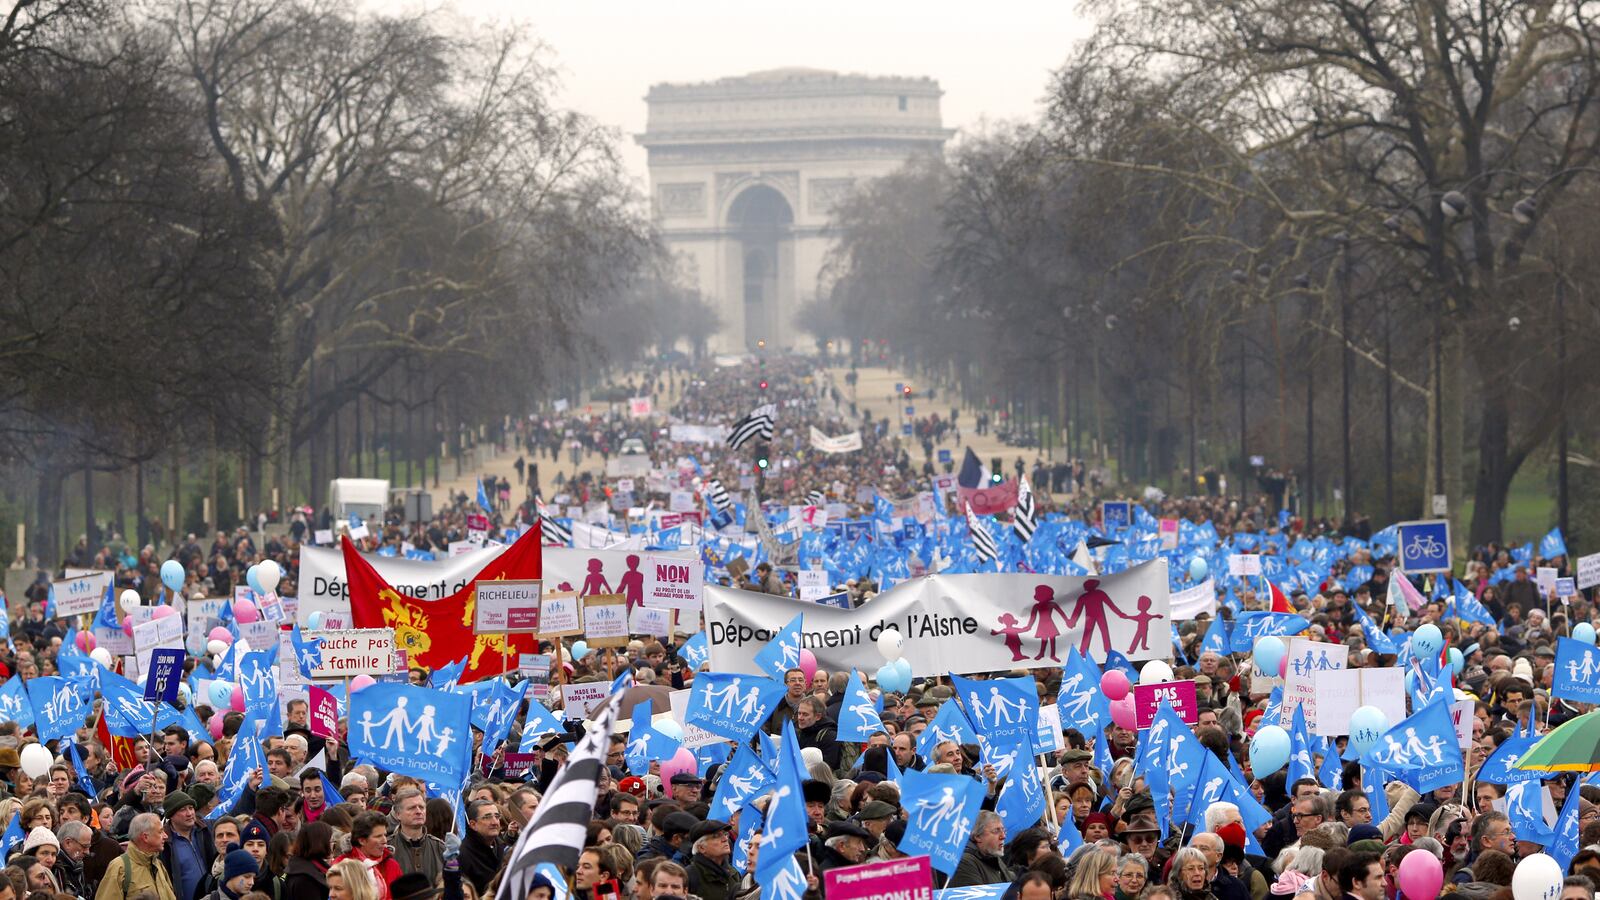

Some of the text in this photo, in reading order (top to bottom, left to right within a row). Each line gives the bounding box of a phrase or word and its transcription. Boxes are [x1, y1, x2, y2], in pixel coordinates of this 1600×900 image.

[656, 564, 690, 584] NON
[314, 576, 446, 600] Dépment
[480, 591, 528, 600] RICHELIEU
[326, 619, 342, 629] NON
[710, 618, 862, 649] Déparment
[908, 614, 978, 638] l'Aisne
[311, 636, 389, 650] ouche pas
[329, 656, 379, 669] famille
[1154, 687, 1177, 701] PAS
[1296, 684, 1314, 693] TOUS
[684, 734, 704, 742] POUR
[995, 728, 1016, 738] Pour
[1490, 774, 1503, 782] La
[1505, 771, 1530, 782] Manif
[893, 862, 920, 874] Enfant
[914, 886, 930, 900] LE
